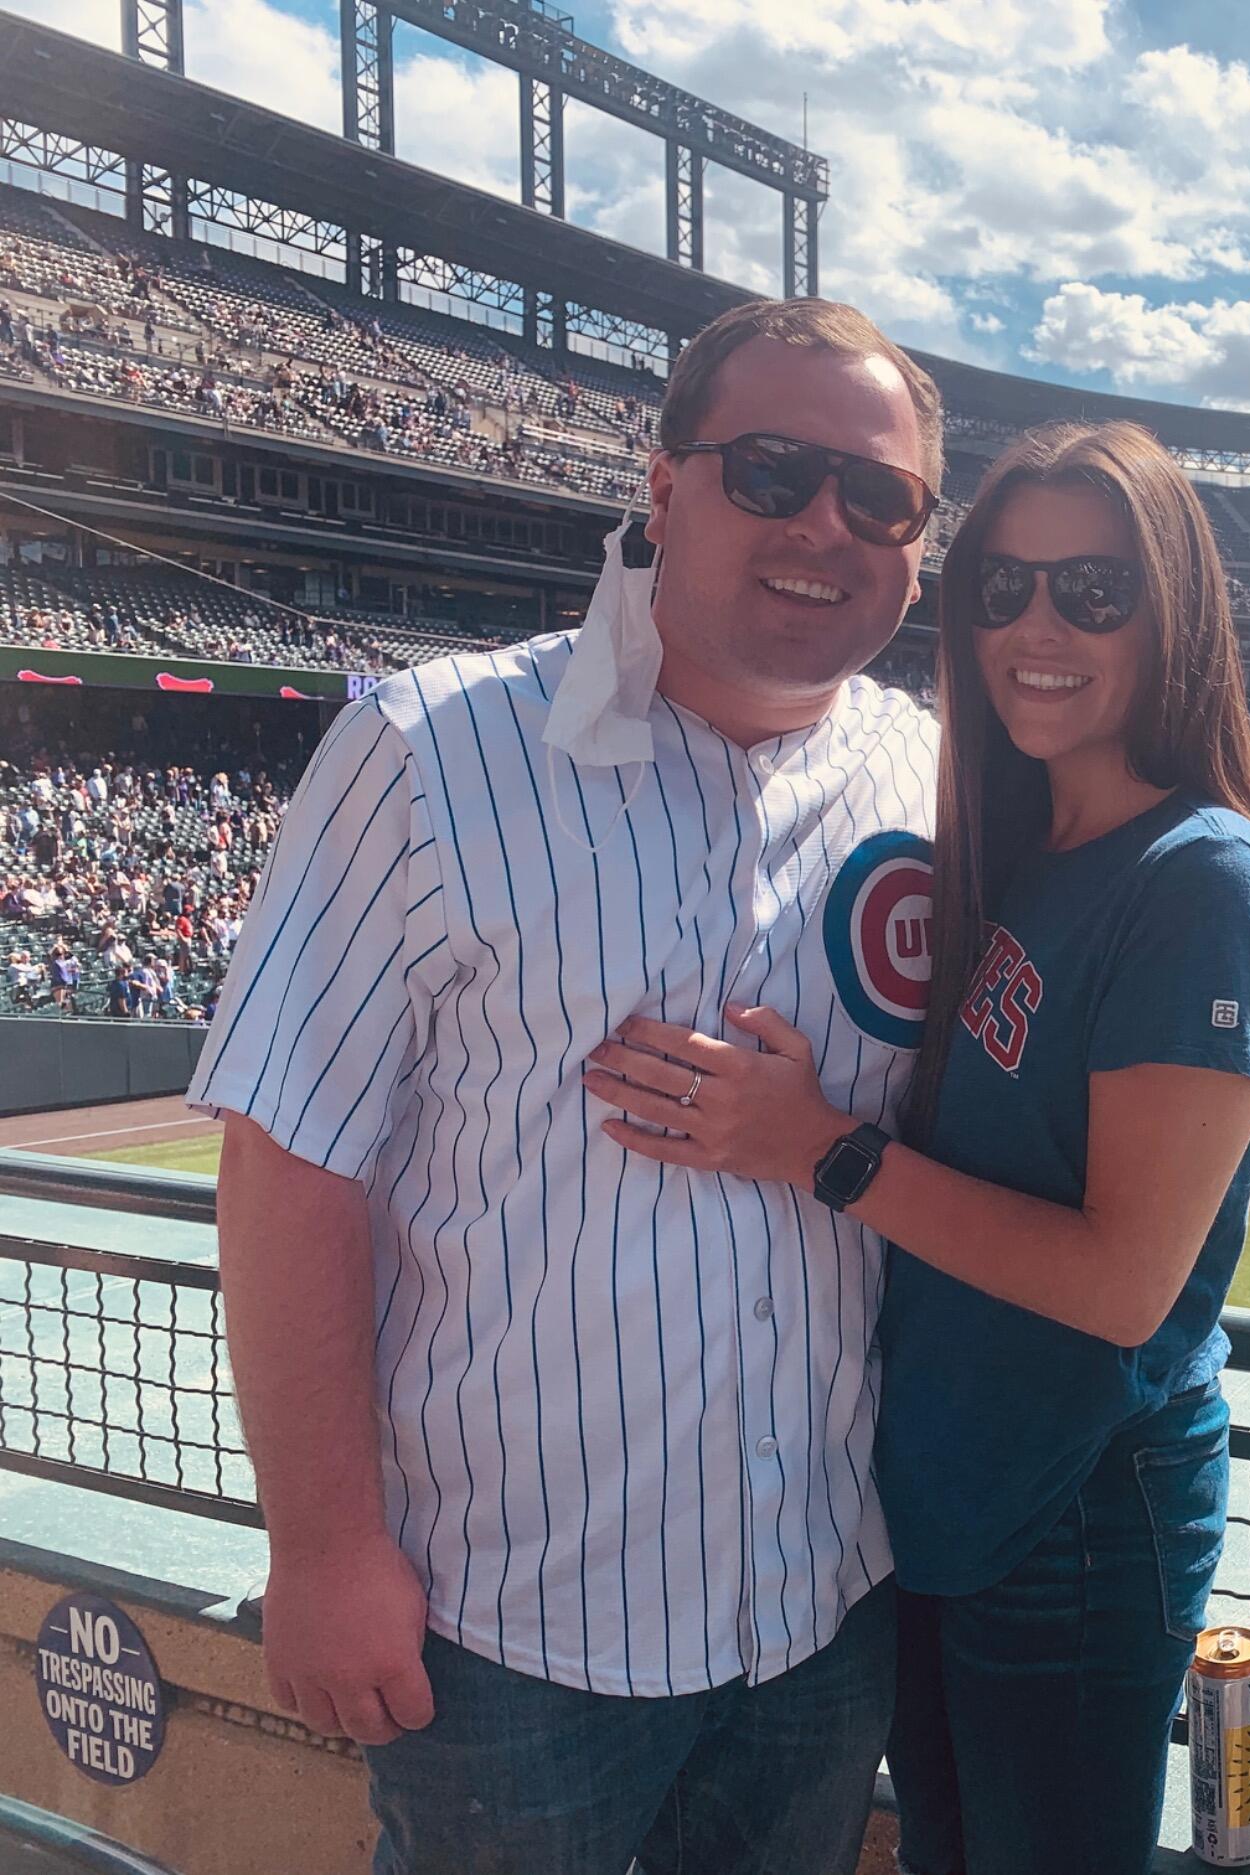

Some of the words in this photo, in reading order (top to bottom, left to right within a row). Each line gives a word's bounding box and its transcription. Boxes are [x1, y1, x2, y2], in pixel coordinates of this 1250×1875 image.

[347, 675, 378, 700] RO
[960, 920, 1043, 1072] ES
[69, 1606, 120, 1665] NO
[38, 1648, 156, 1716] TRESPASSING
[46, 1689, 104, 1734] ONTO
[109, 1709, 153, 1751] THE
[67, 1728, 135, 1779] FIELD
